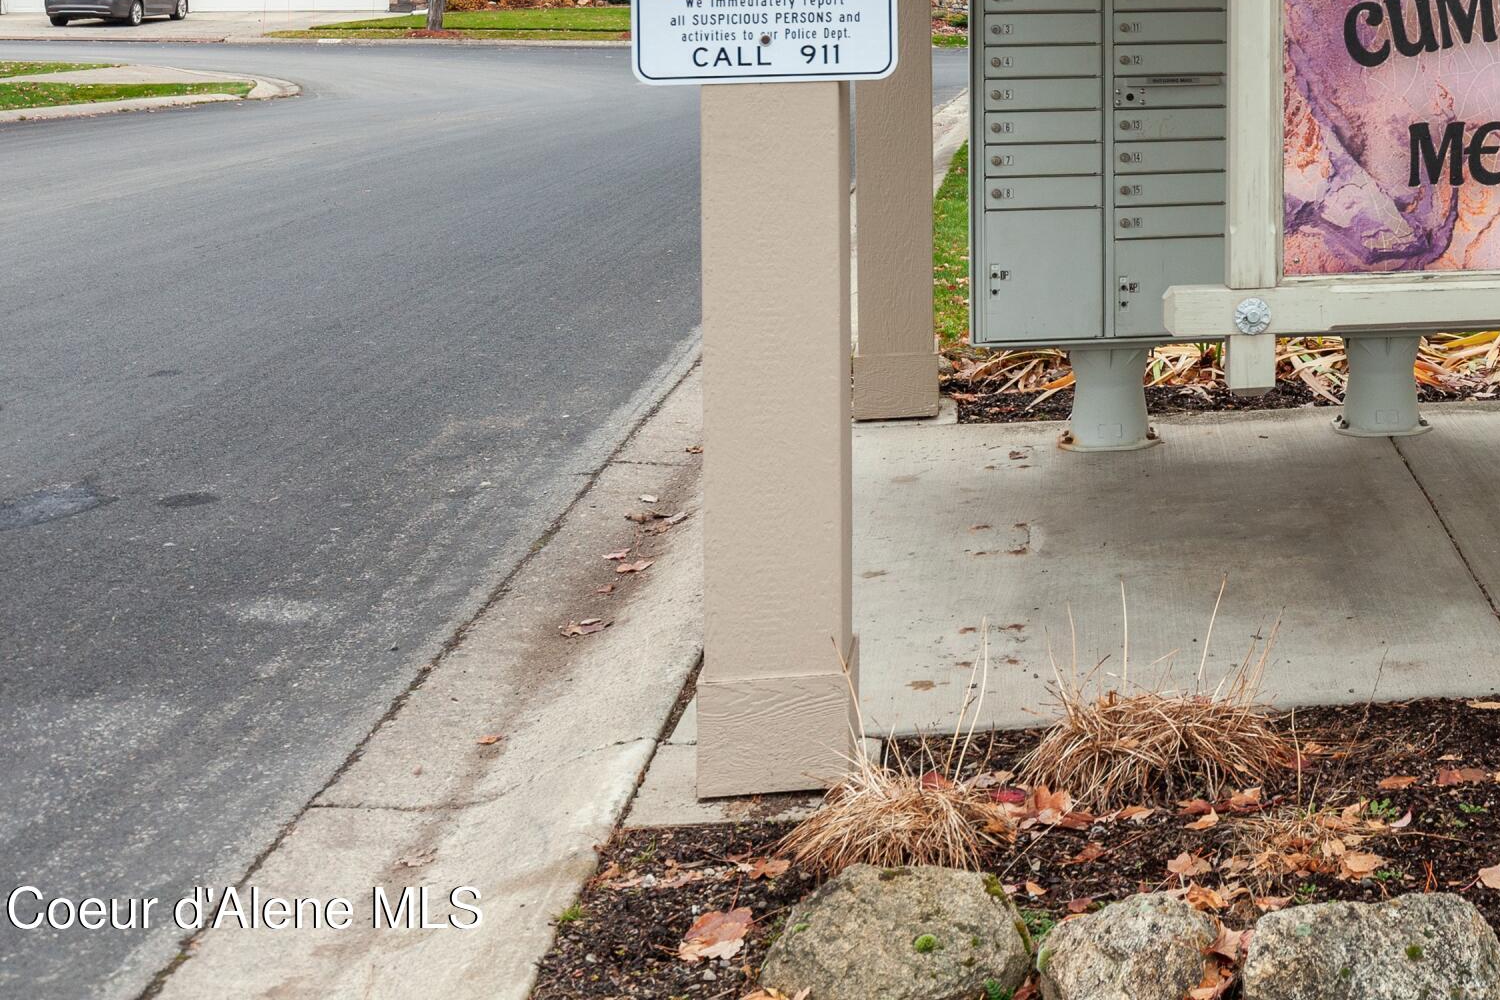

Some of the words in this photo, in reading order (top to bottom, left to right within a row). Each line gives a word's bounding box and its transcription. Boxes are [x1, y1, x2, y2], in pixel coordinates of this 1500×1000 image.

[670, 15, 685, 27] all
[692, 12, 769, 26] SUSPICIOUS
[775, 11, 833, 24] PERSONS
[839, 11, 861, 23] and
[681, 30, 736, 42] activities
[743, 30, 754, 41] to
[785, 28, 817, 40] Police
[823, 27, 850, 41] Dept.
[692, 45, 772, 68] CALL
[800, 43, 840, 65] 911
